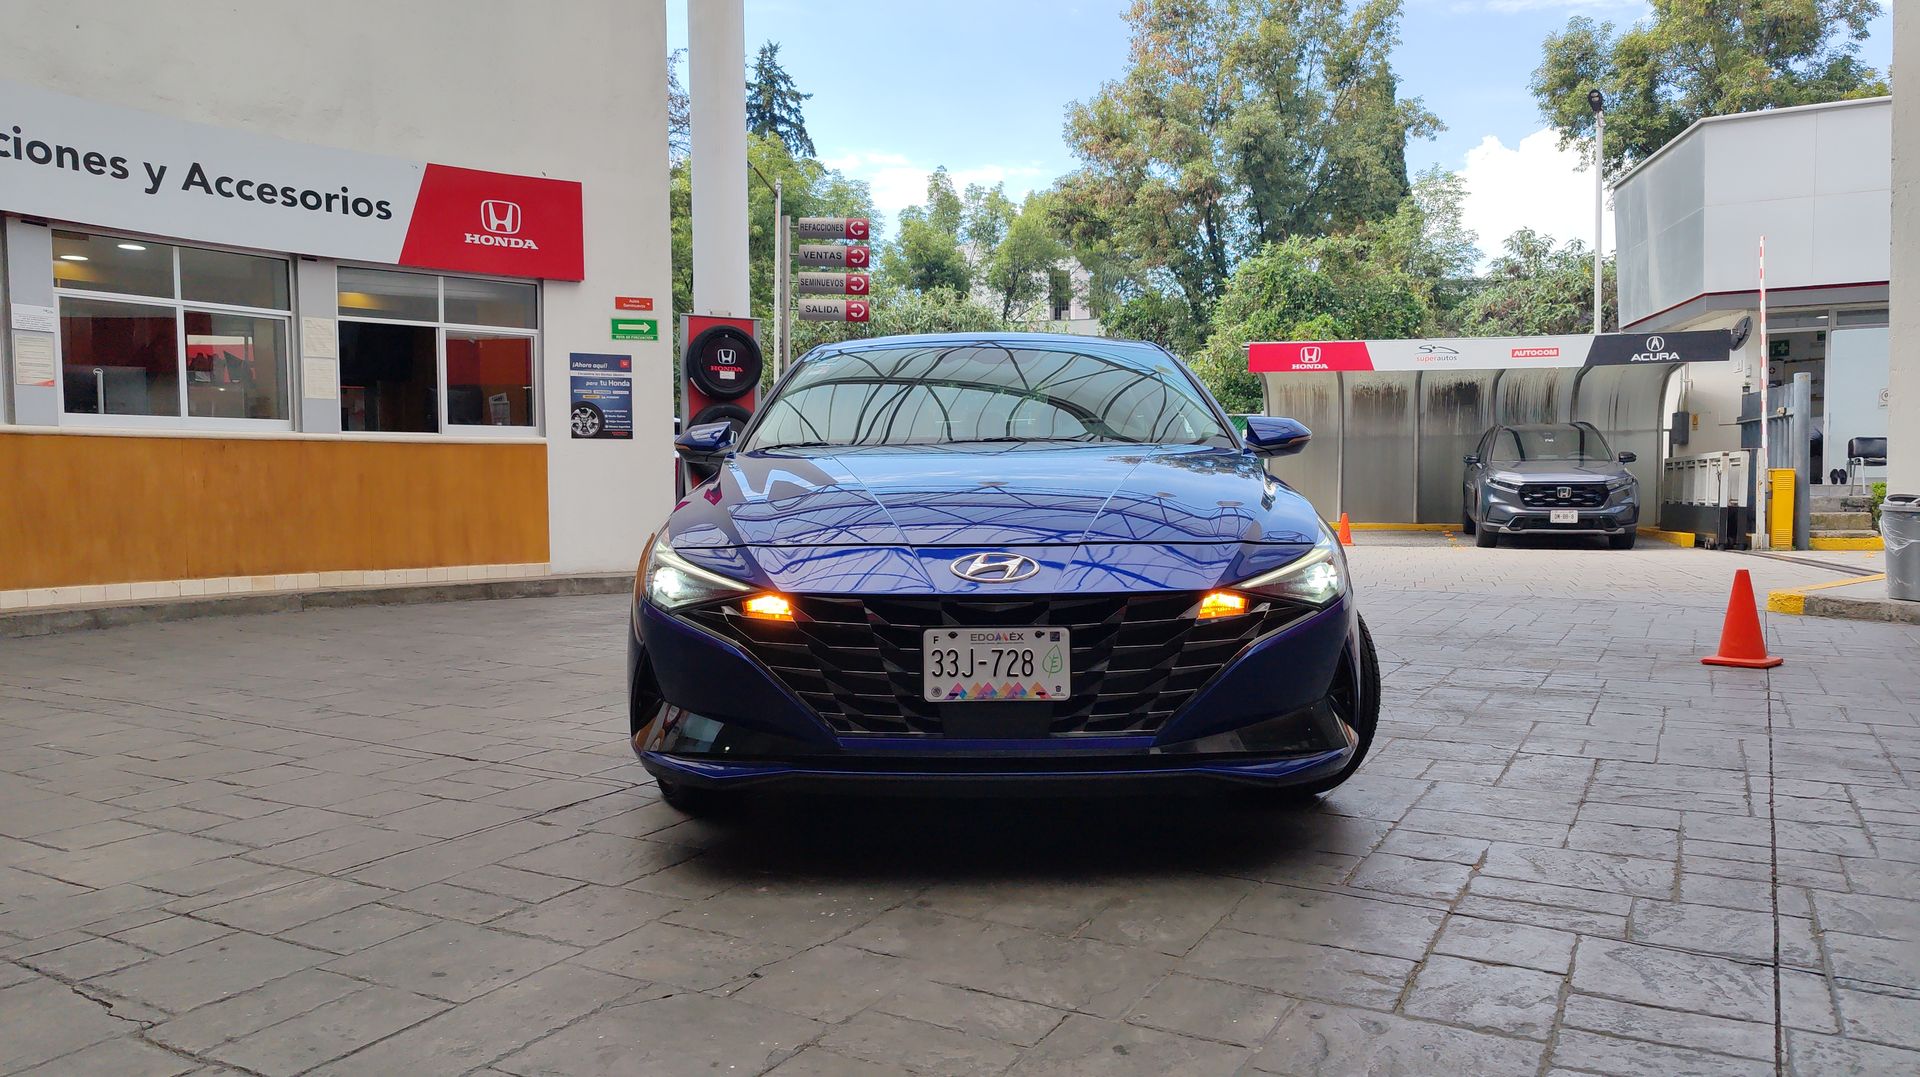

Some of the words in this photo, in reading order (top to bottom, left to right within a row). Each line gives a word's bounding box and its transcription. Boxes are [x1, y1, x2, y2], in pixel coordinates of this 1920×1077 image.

[143, 161, 167, 195] y
[181, 162, 392, 220] Accesorios
[800, 223, 844, 232] REFACCIONES
[464, 232, 539, 250] HONDA
[803, 251, 842, 260] VENTAS
[800, 278, 844, 287] SEMINUEVOS
[805, 304, 839, 314] SALIDA
[1630, 351, 1680, 362] ACURA
[608, 379, 630, 387] Honda
[933, 635, 940, 645] F
[931, 648, 1034, 678] 33J-728
